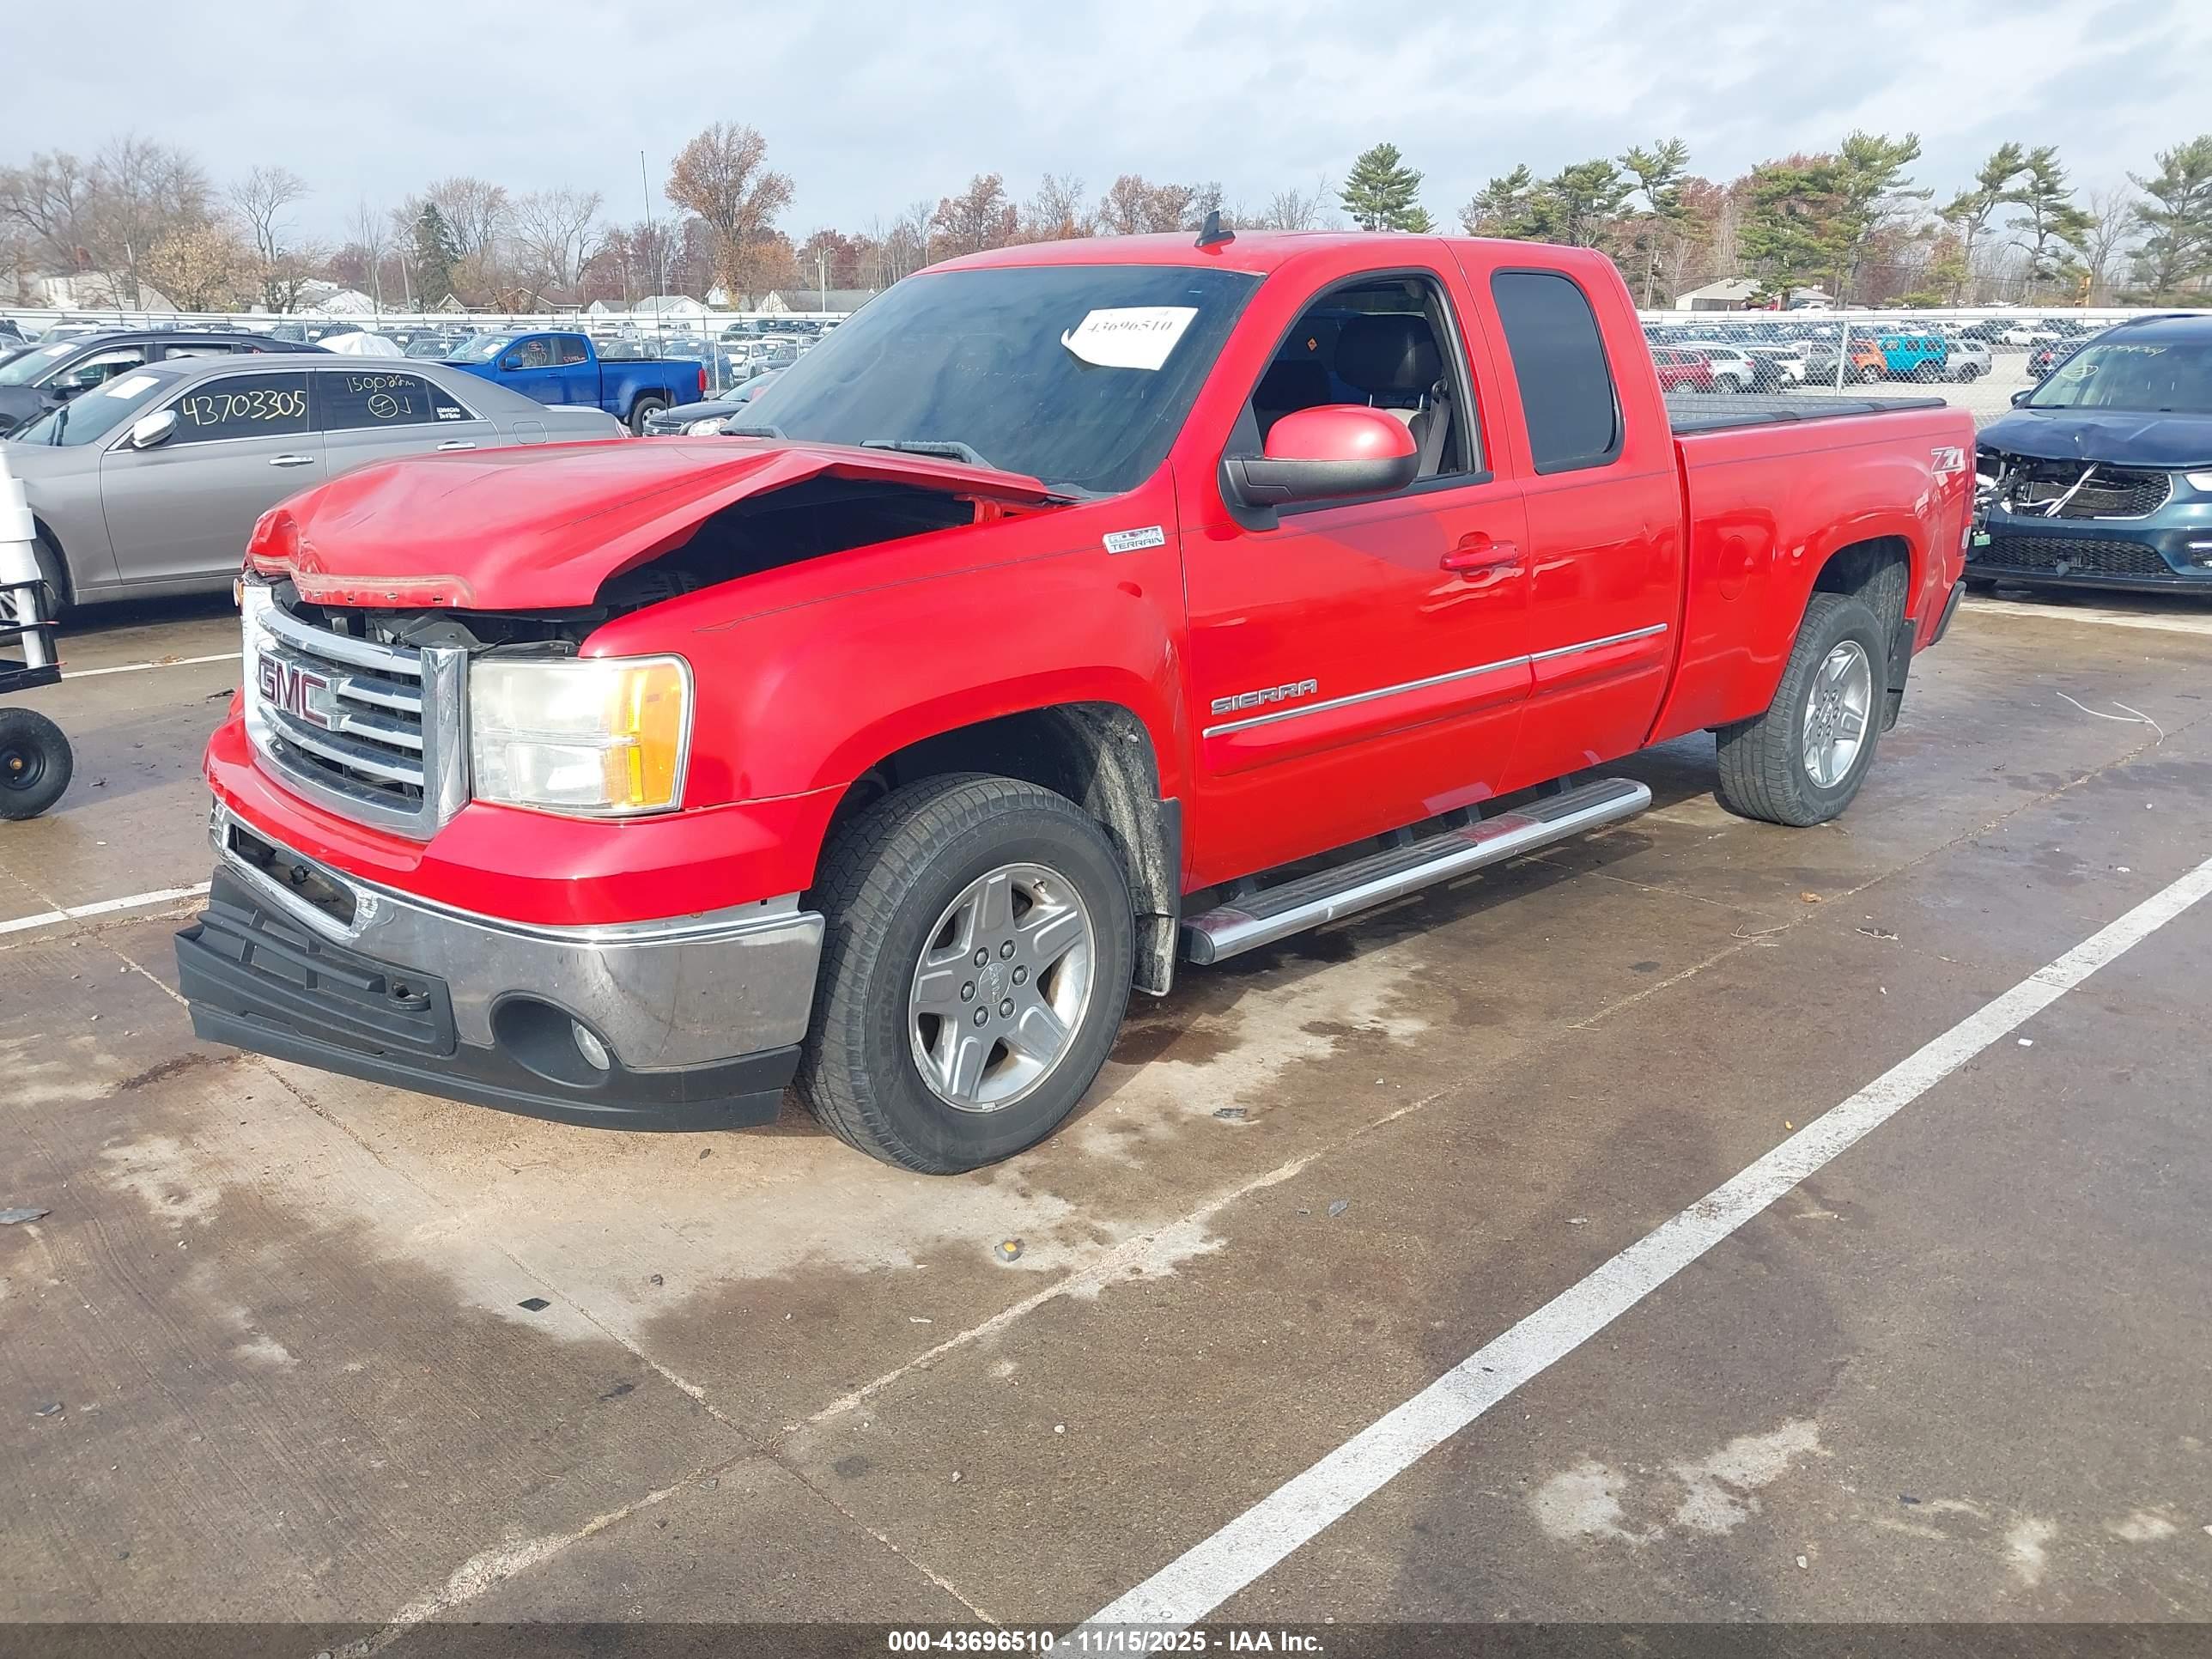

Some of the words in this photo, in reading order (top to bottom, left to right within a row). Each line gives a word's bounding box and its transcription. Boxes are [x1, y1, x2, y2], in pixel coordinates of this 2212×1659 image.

[183, 390, 307, 426] 43703305
[1930, 446, 1966, 474] Z71
[1110, 537, 1163, 550] TERRAIN
[258, 651, 338, 732] GMC
[1211, 678, 1317, 715] SIERRA
